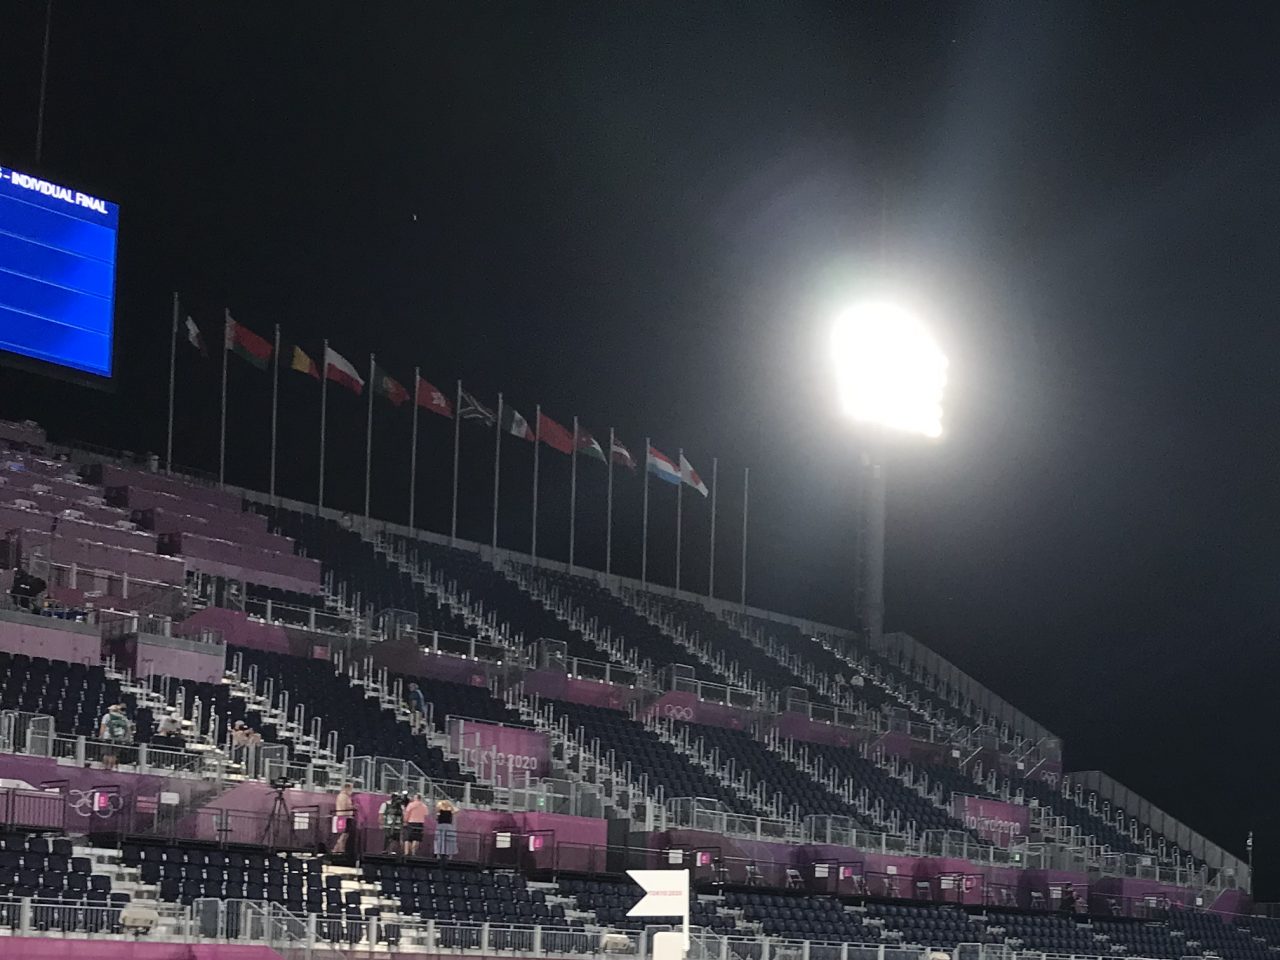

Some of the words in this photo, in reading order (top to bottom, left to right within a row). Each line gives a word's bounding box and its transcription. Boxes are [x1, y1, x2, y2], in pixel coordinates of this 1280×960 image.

[12, 171, 75, 204] INDIVIDUAL
[76, 192, 108, 215] FINAL
[507, 754, 538, 770] 2020
